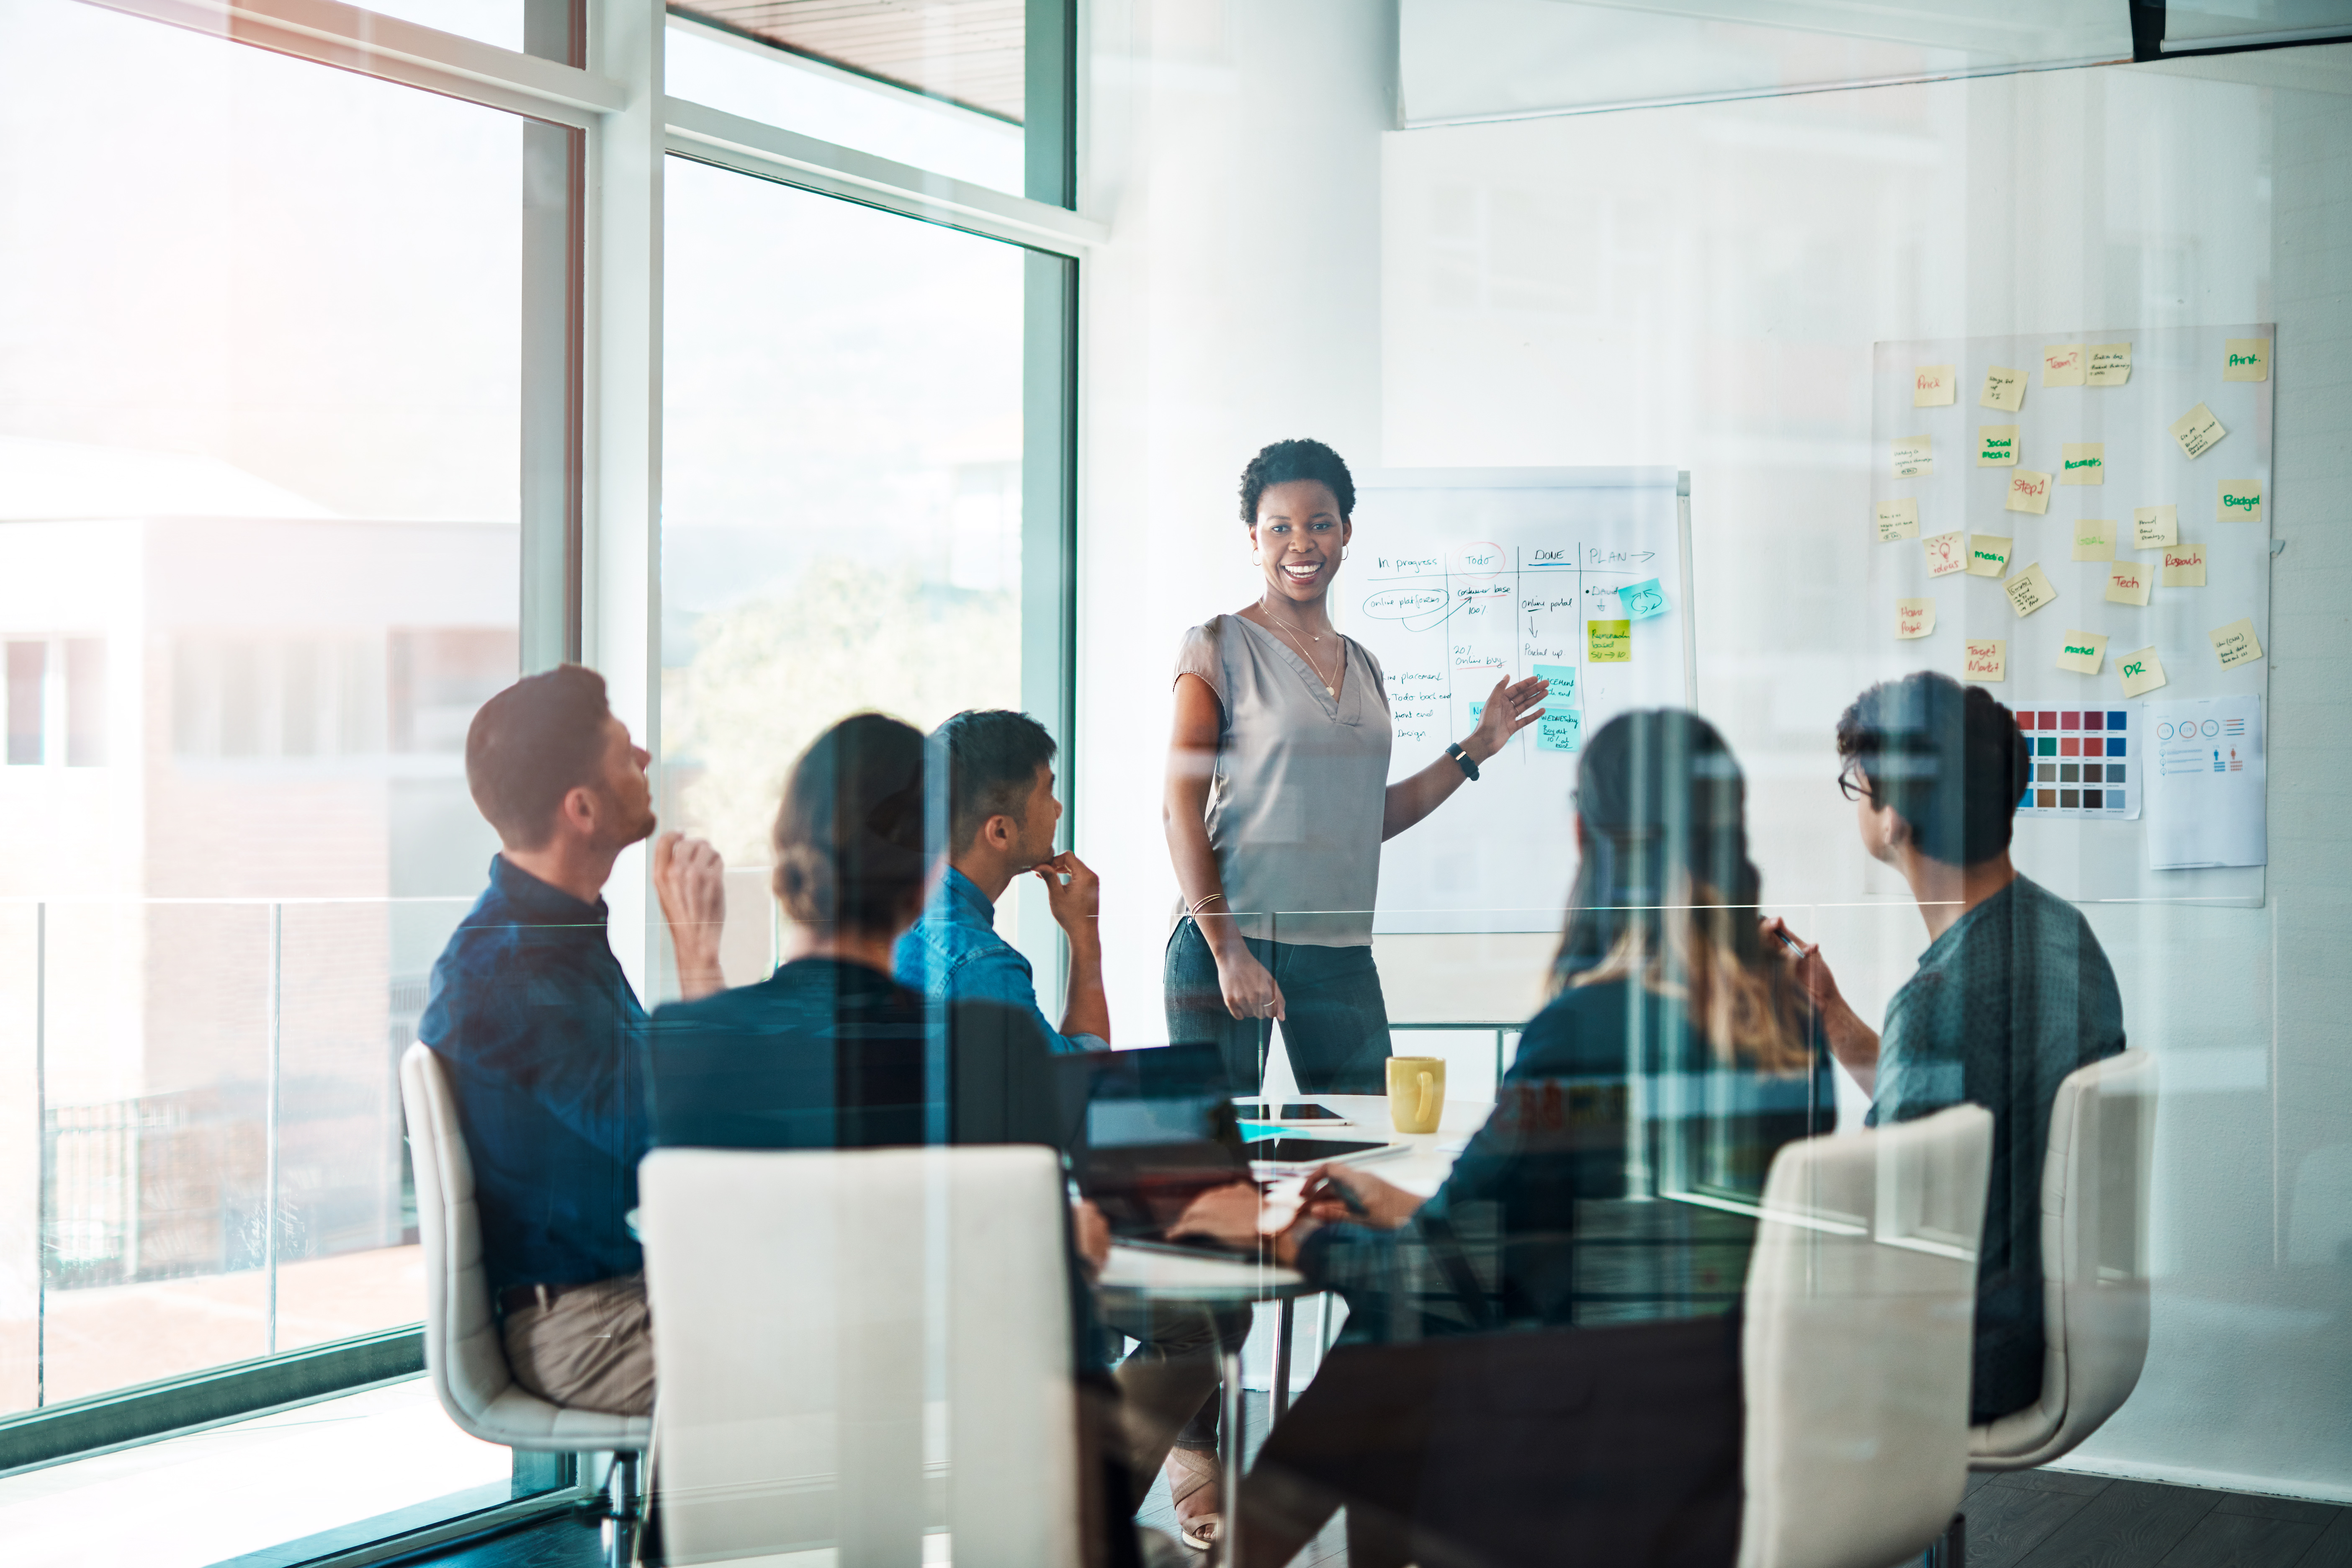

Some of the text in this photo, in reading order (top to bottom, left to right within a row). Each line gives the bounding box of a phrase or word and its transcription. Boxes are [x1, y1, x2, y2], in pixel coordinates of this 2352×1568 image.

[2046, 352, 2078, 370] Team?
[1917, 374, 1940, 390] Price
[1987, 438, 2011, 448] Social
[2014, 479, 2044, 497] Step 1
[2223, 494, 2260, 512] Budget
[1465, 555, 1495, 565] Todo
[1535, 550, 1565, 560] DONE
[1590, 548, 1627, 564] PLAN
[2166, 553, 2202, 568] Research
[1379, 557, 1438, 573] In progress
[1934, 560, 1959, 573] ideas
[1494, 584, 1512, 594] base
[2113, 576, 2139, 589] Tech
[1371, 596, 1394, 608] online
[1550, 598, 1572, 612] portal
[1401, 672, 1444, 685] placement
